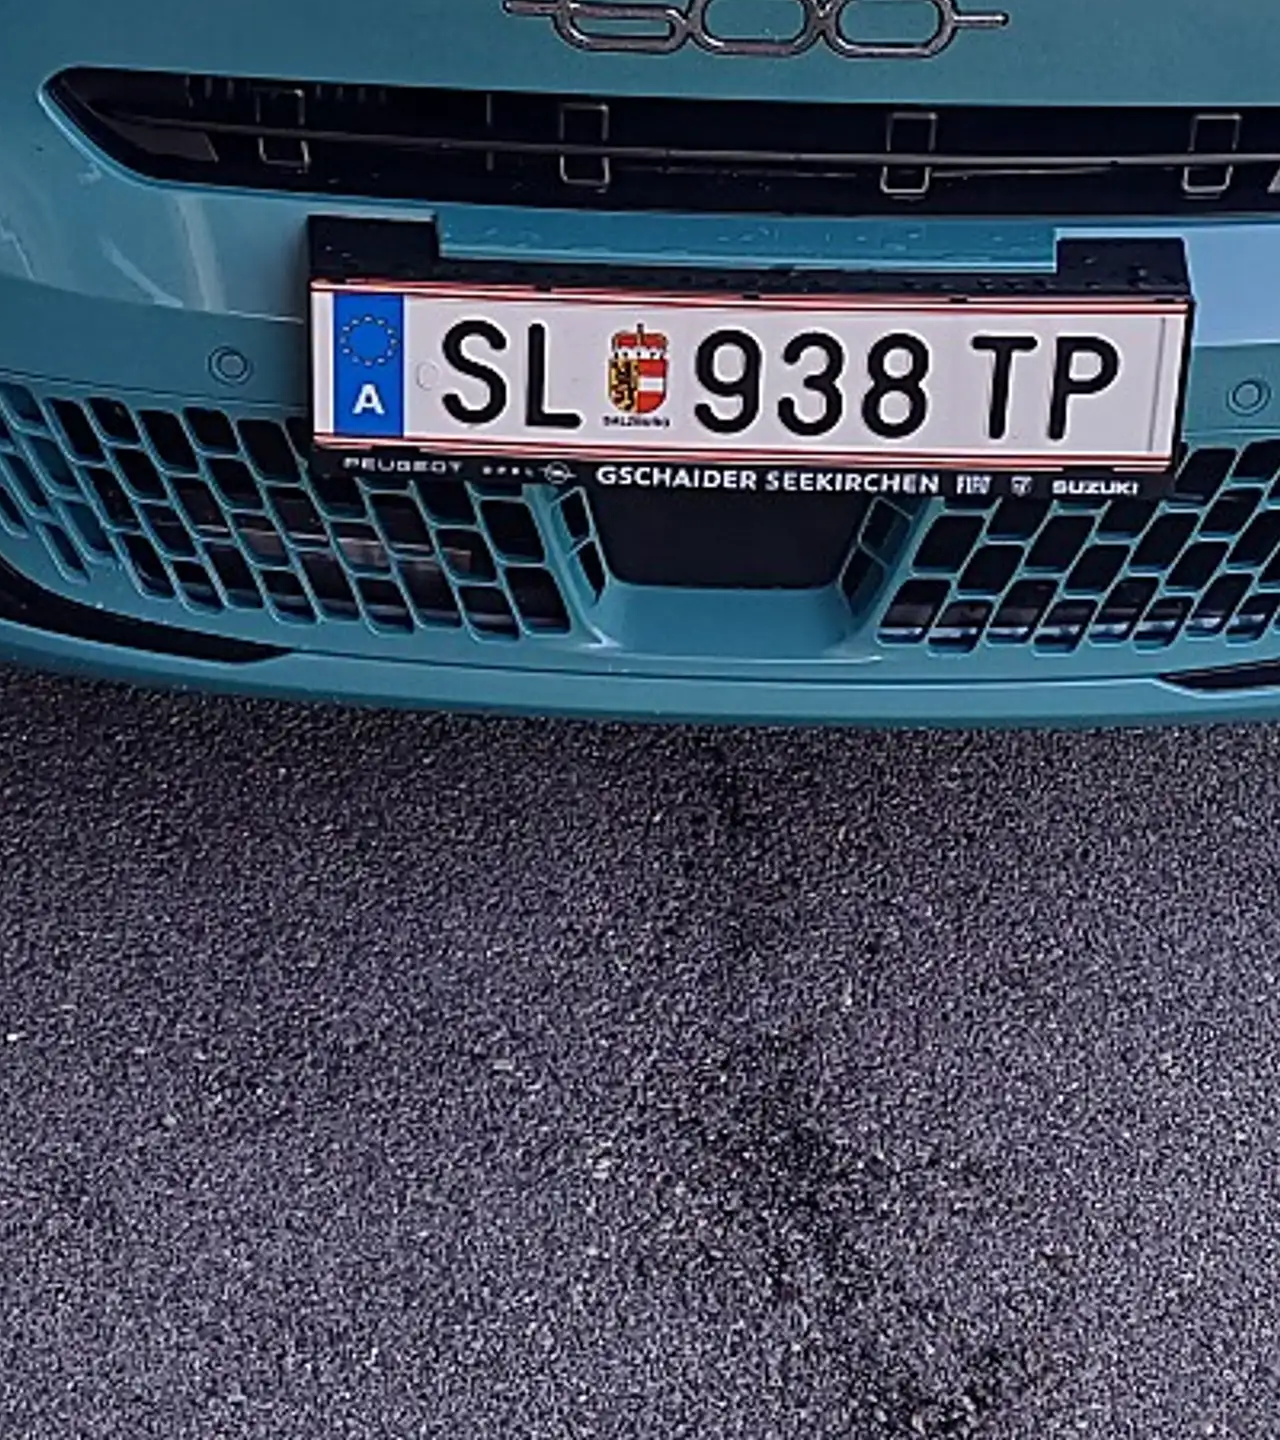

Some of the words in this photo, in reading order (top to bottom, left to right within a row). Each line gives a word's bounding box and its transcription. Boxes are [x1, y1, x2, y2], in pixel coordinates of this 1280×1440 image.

[352, 384, 385, 416] A
[442, 320, 582, 429] SL
[694, 329, 930, 439] 938
[972, 335, 1119, 440] TP
[343, 457, 463, 474] PEUGEOT
[595, 465, 757, 491] GSCHAIDER
[764, 470, 939, 495] SEEKIRCHEN
[1052, 479, 1139, 497] SUZUKI
